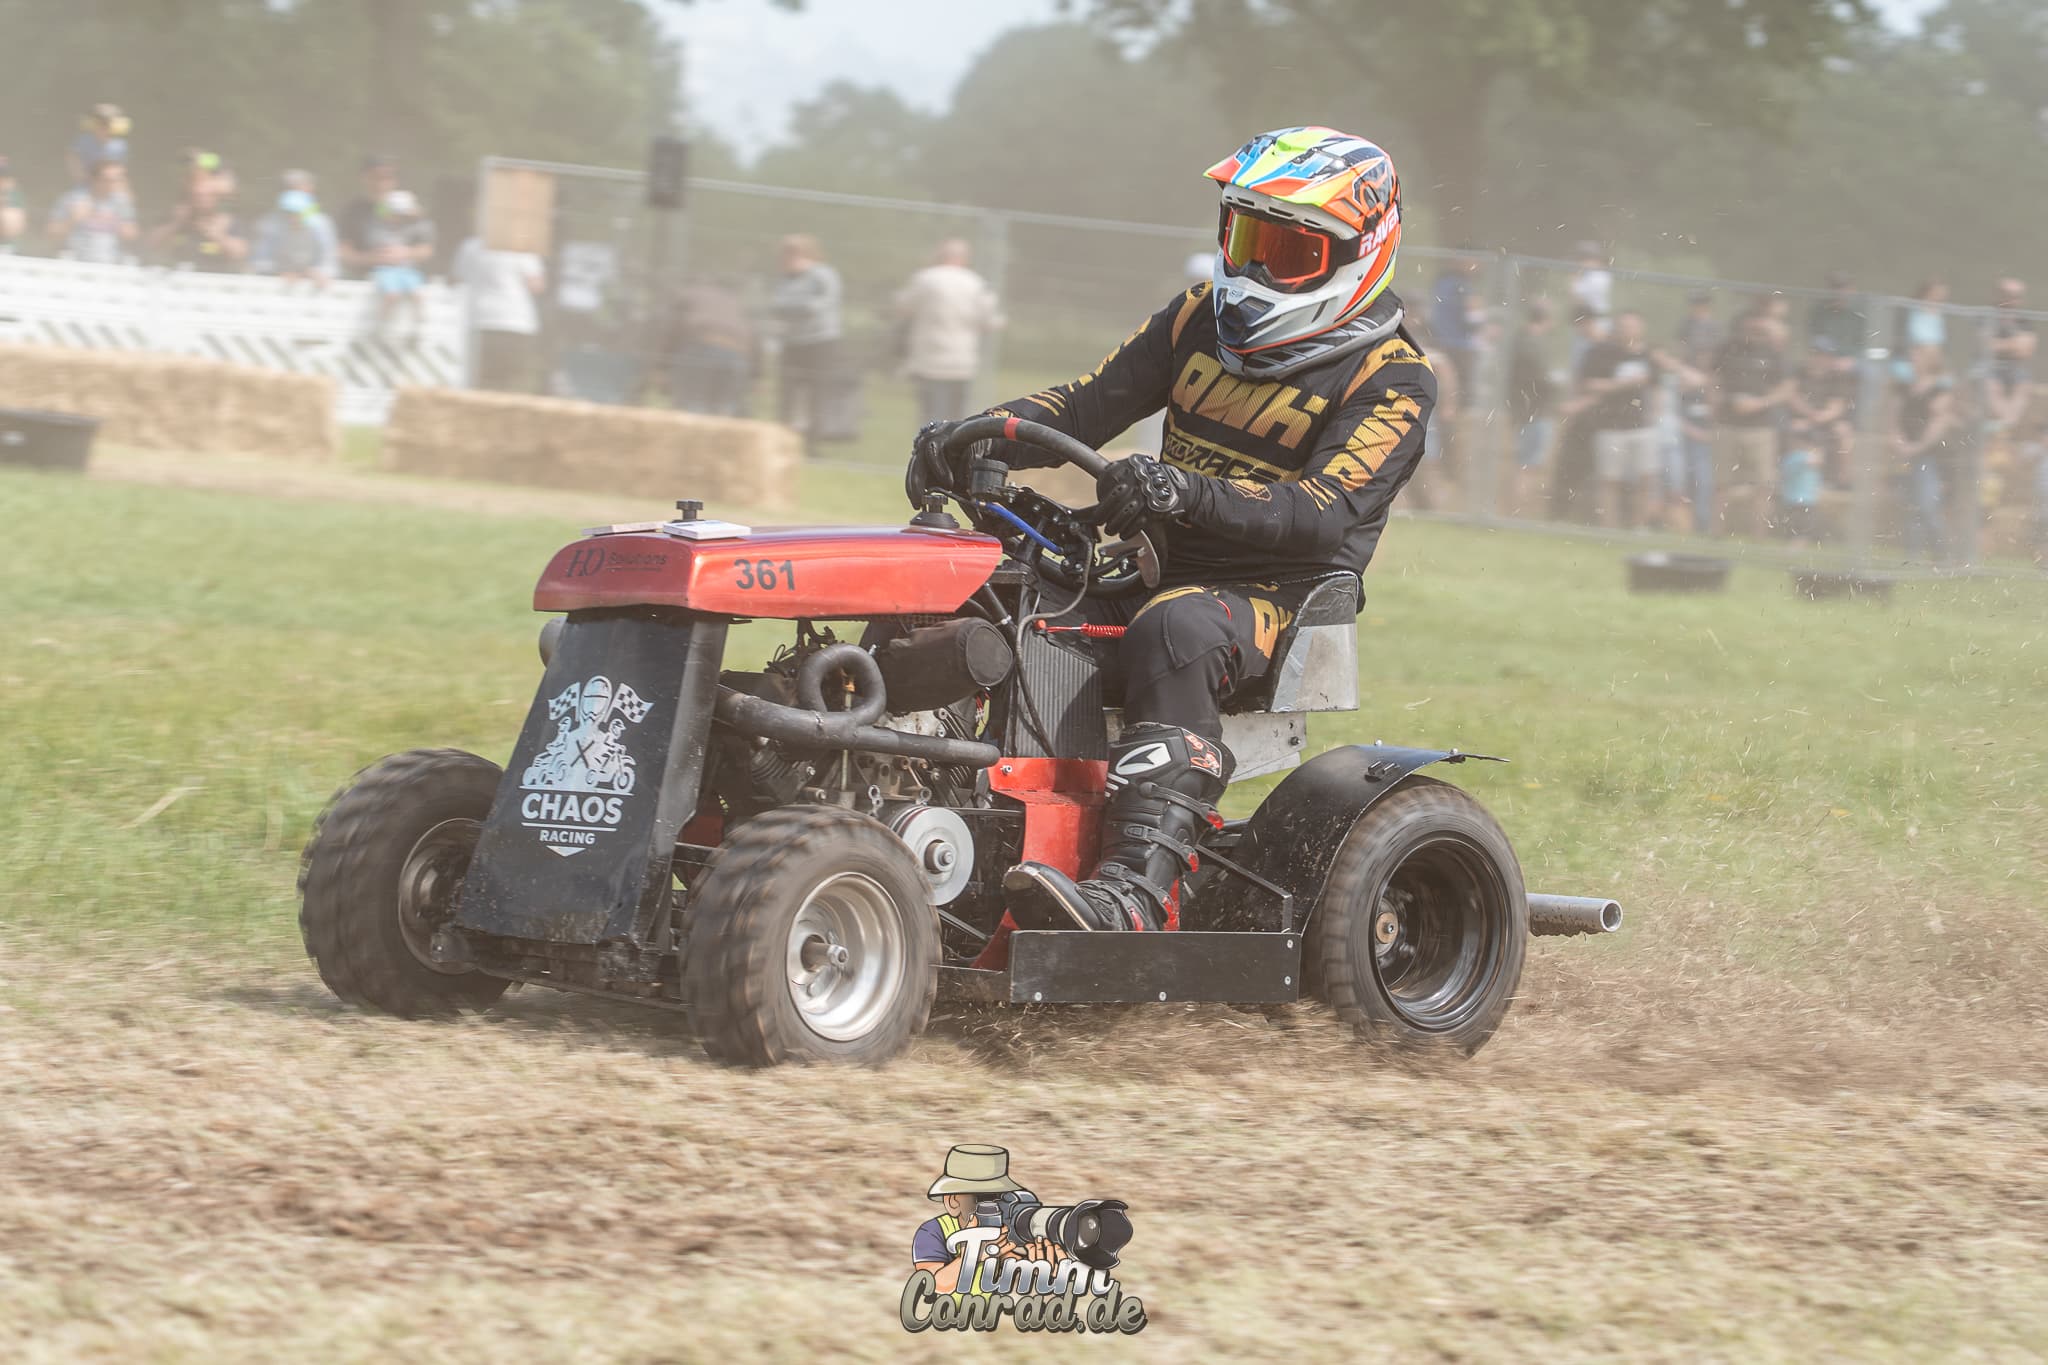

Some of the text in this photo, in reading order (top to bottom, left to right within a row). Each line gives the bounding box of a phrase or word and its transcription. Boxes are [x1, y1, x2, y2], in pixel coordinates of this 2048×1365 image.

[734, 559, 796, 590] 361
[521, 793, 624, 824] CHAOS
[539, 830, 596, 844] RACING
